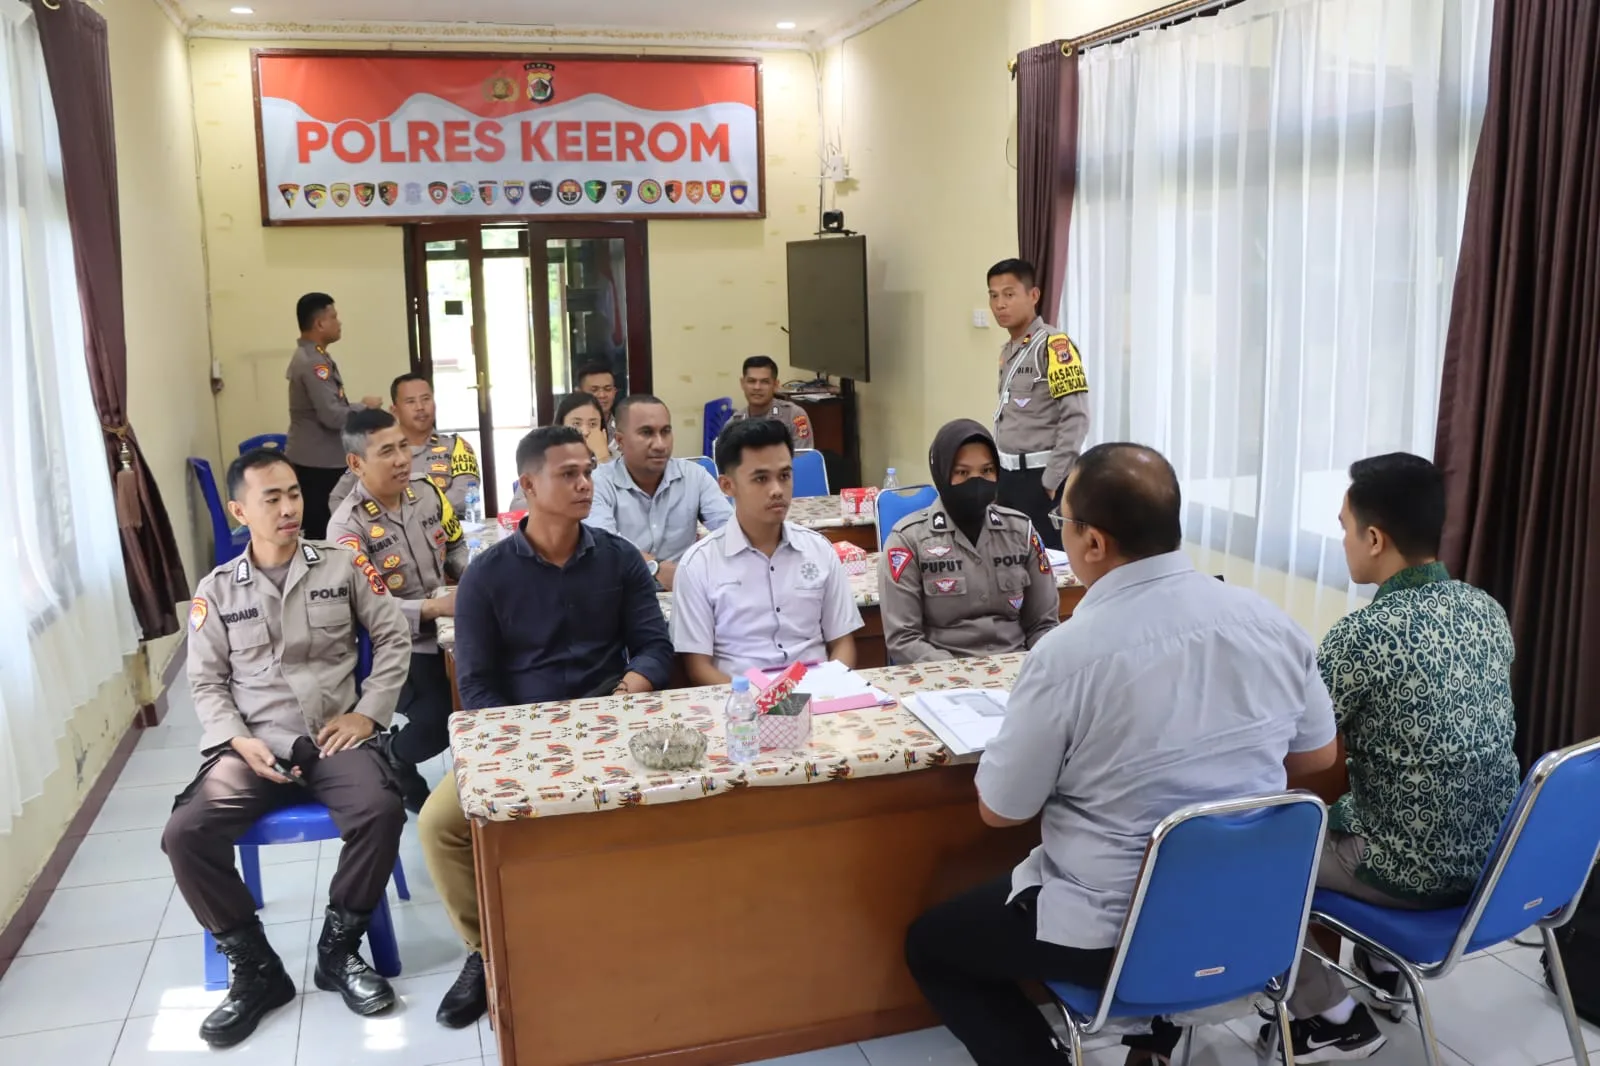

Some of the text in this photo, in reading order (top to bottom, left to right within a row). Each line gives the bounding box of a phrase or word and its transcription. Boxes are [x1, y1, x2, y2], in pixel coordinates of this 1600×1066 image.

[296, 119, 730, 164] POLRES KEEROM
[921, 560, 963, 573] PUPUT
